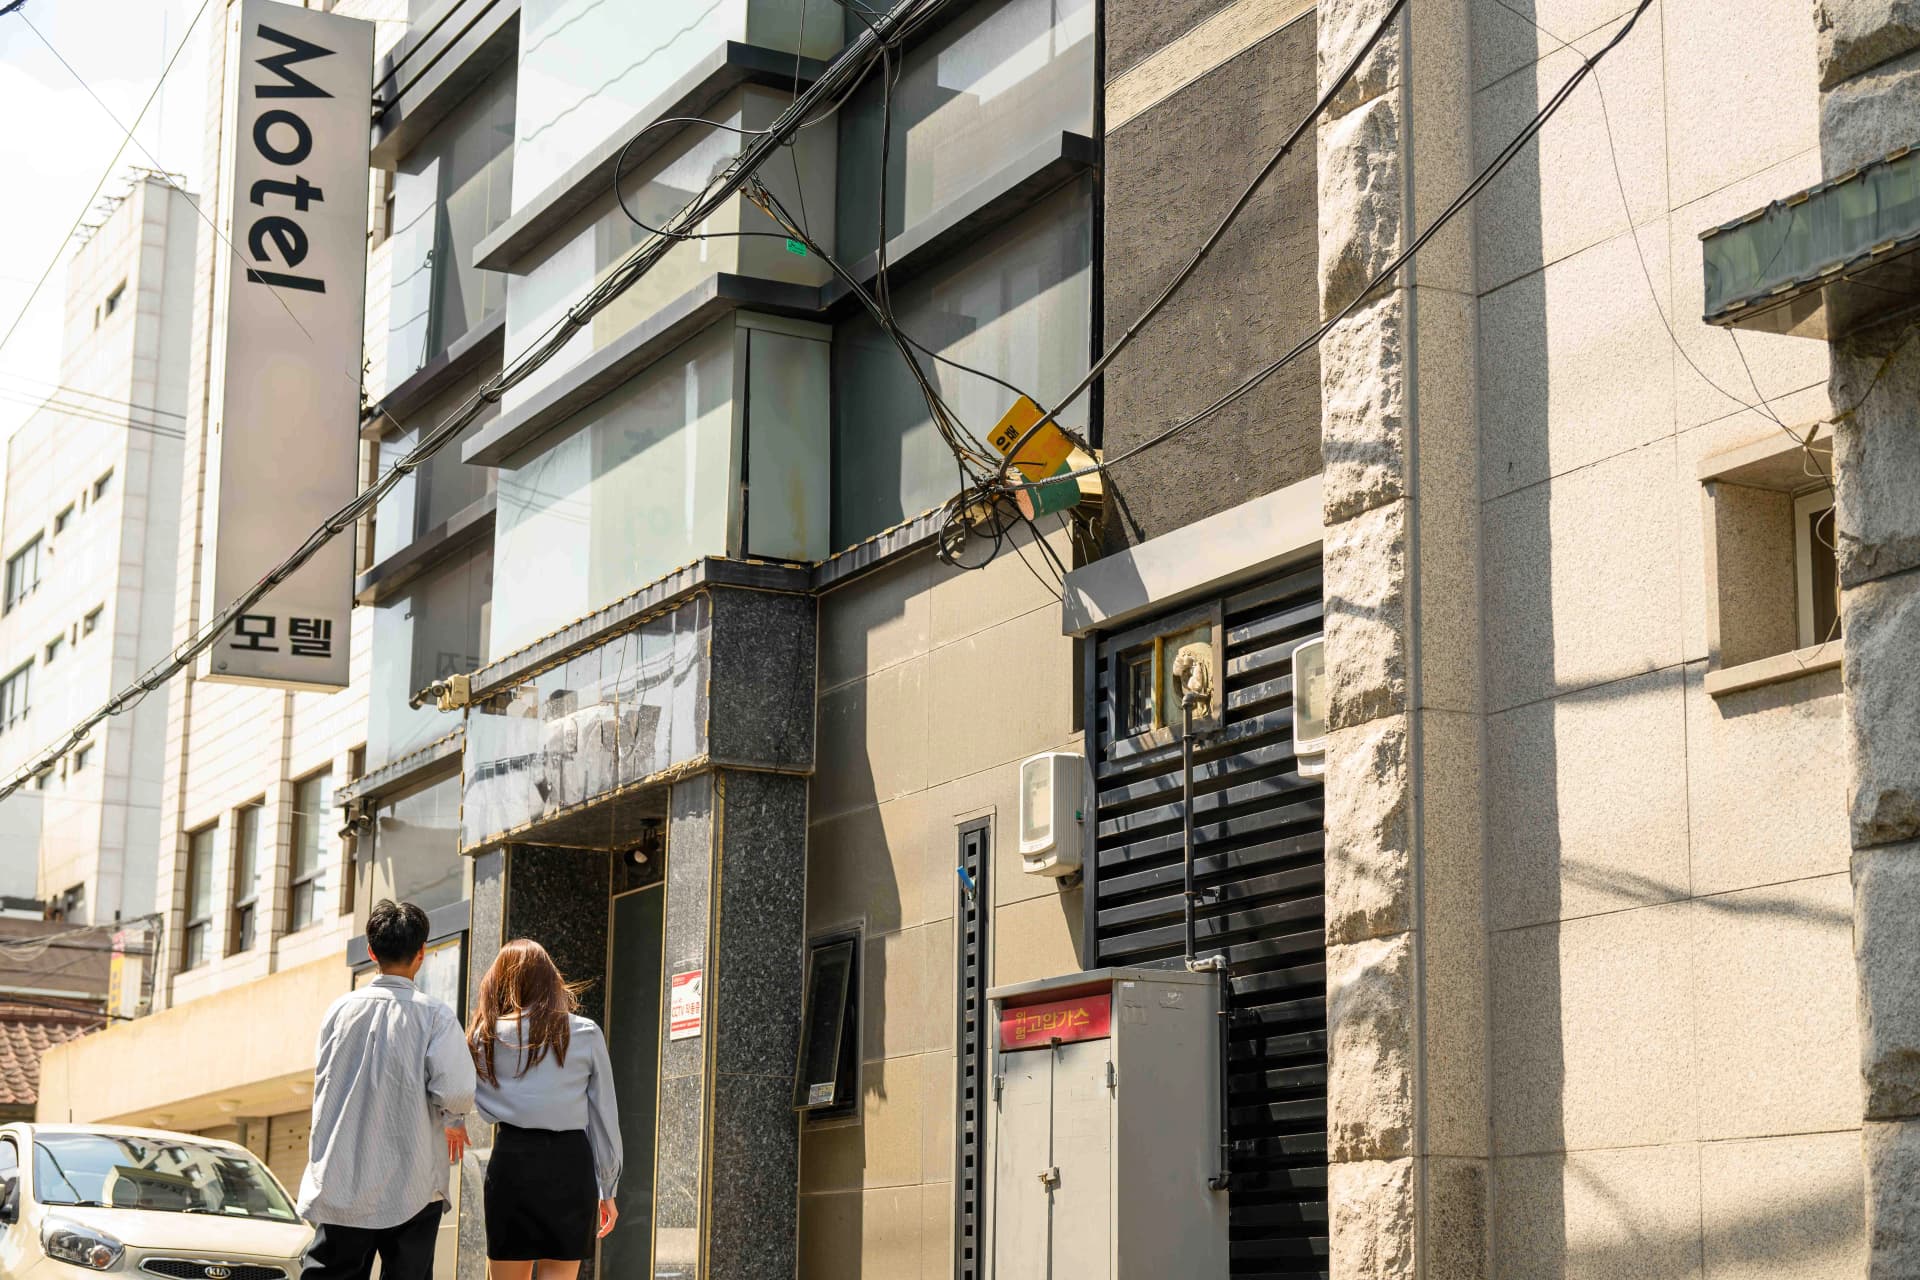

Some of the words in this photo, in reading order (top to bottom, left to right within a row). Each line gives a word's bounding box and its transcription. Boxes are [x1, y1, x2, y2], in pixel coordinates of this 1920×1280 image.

[247, 24, 337, 293] Motel
[230, 614, 332, 658] 모텔
[1027, 1008, 1089, 1032] 고압가스
[209, 1267, 228, 1276] KIA
